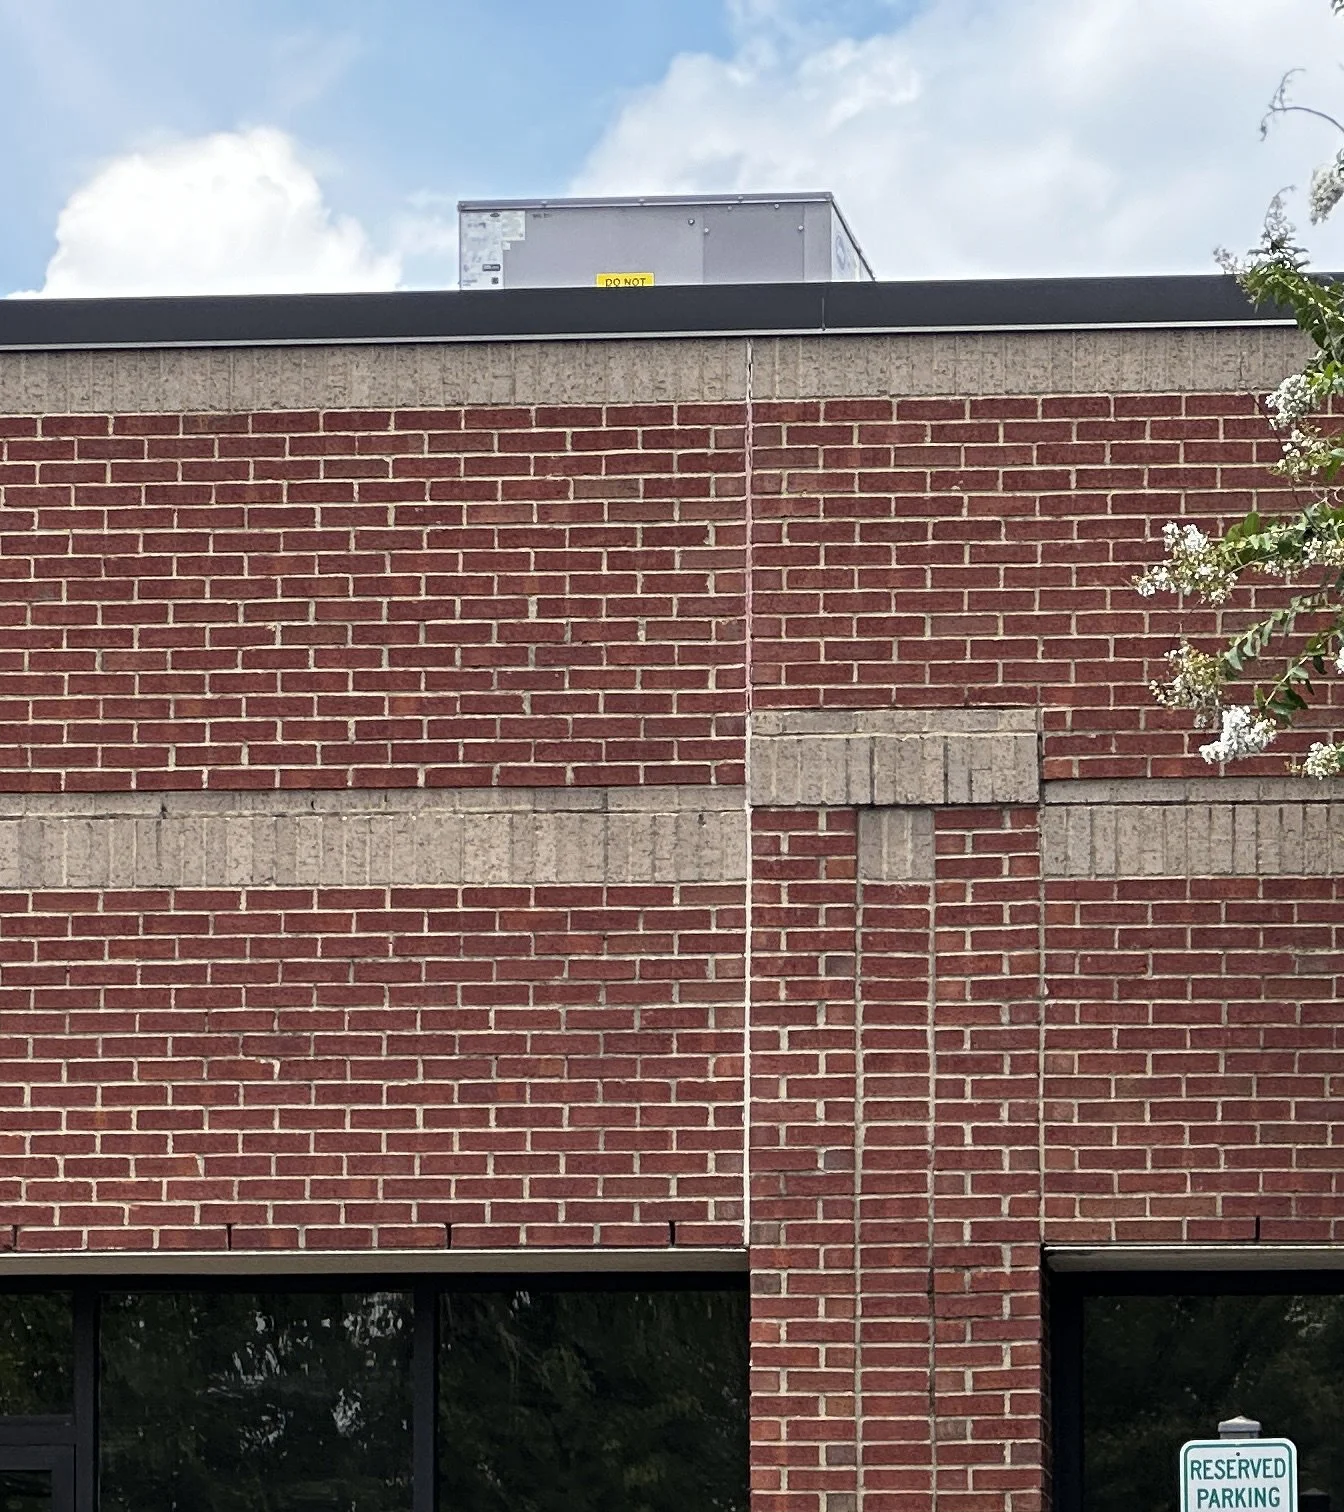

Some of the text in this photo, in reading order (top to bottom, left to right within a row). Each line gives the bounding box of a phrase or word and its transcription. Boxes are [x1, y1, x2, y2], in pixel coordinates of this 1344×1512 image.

[605, 277, 647, 288] DO NOT
[1190, 1457, 1287, 1480] RESERVED
[1197, 1487, 1281, 1509] PARKING
